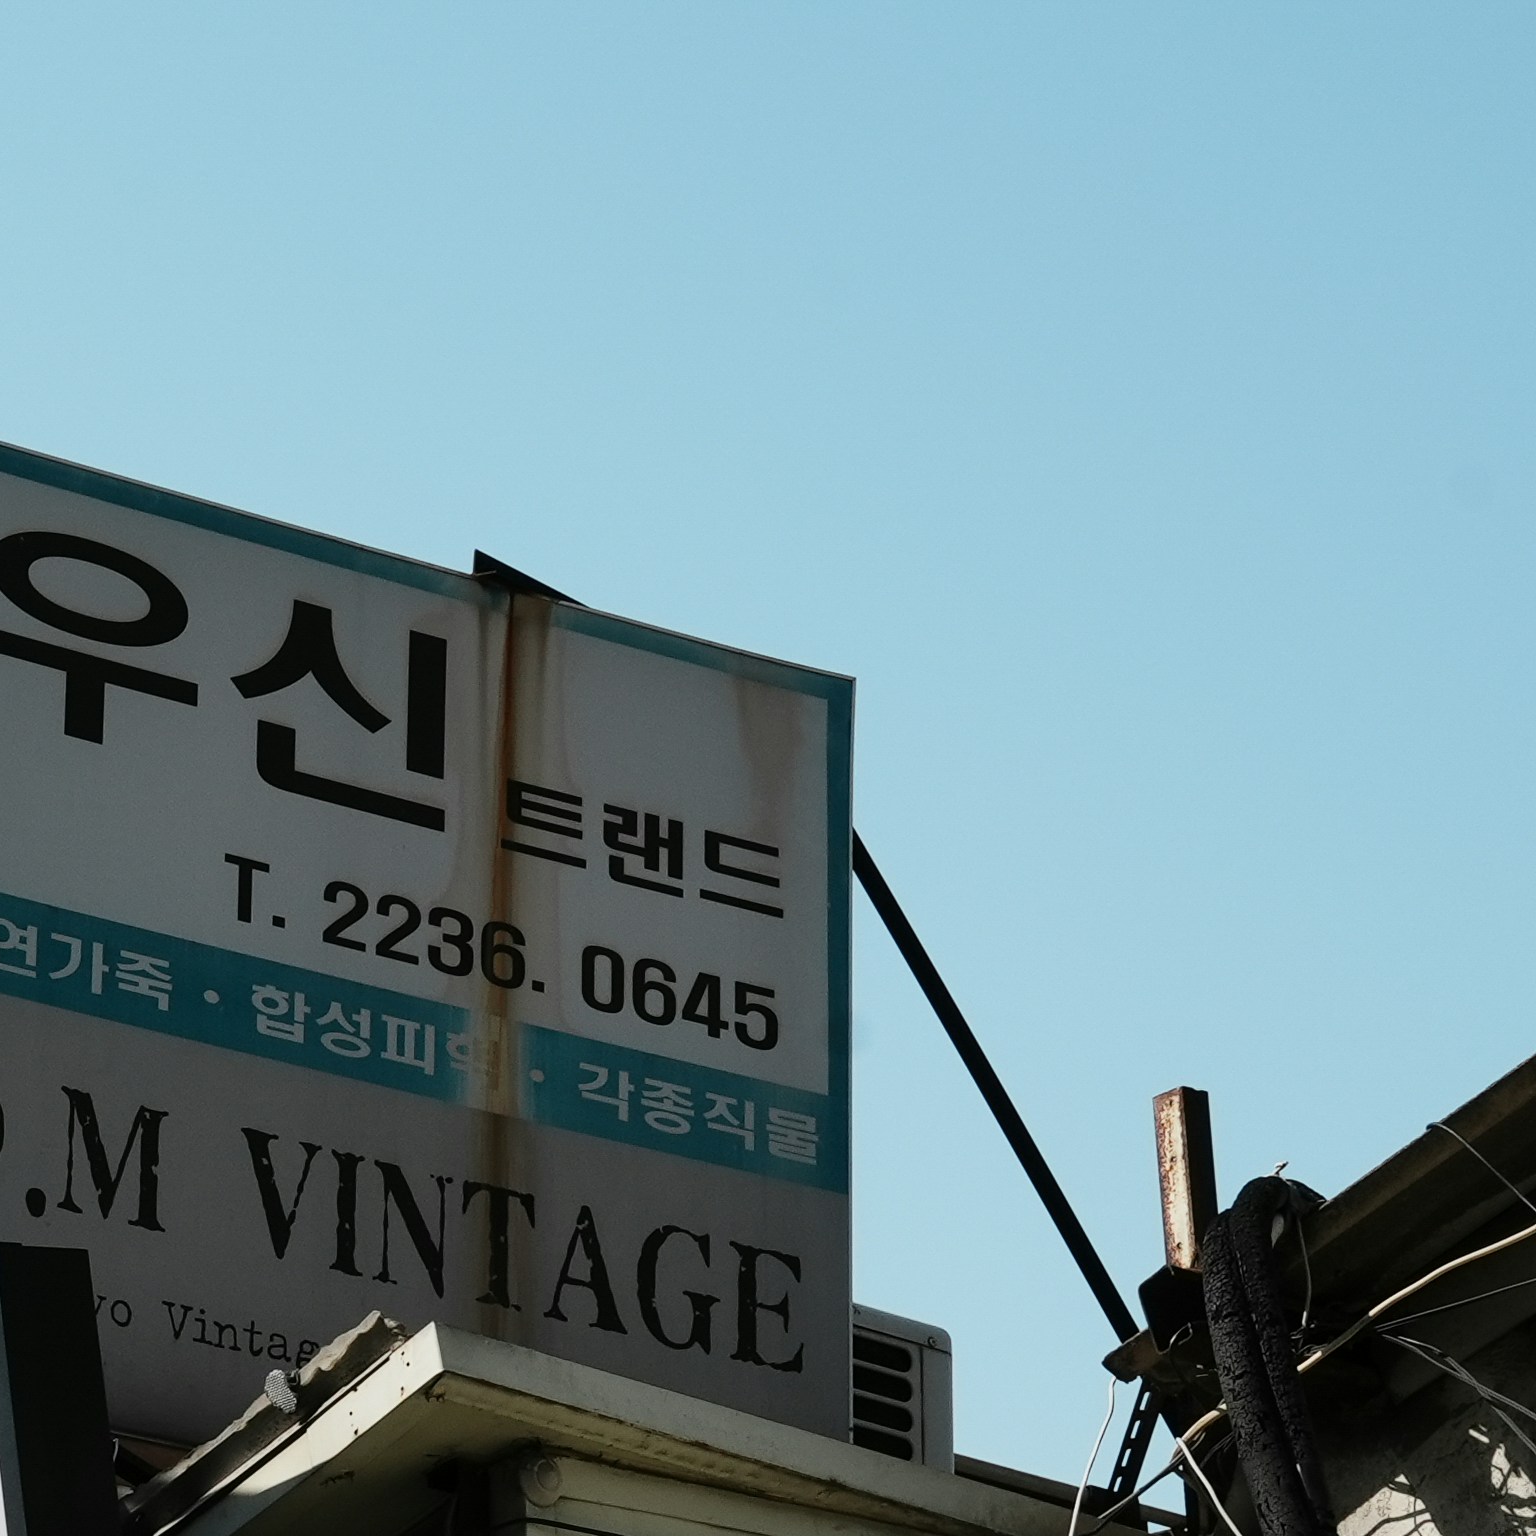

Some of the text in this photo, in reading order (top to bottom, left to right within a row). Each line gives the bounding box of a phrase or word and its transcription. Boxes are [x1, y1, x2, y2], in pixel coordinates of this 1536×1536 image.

[502, 779, 783, 919] 트랜드
[224, 853, 287, 929] T.
[581, 944, 780, 1051] 0645
[578, 1062, 820, 1166] 각종직물
[240, 1126, 805, 1374] VINTAGE
[162, 1300, 320, 1369] Vintag
